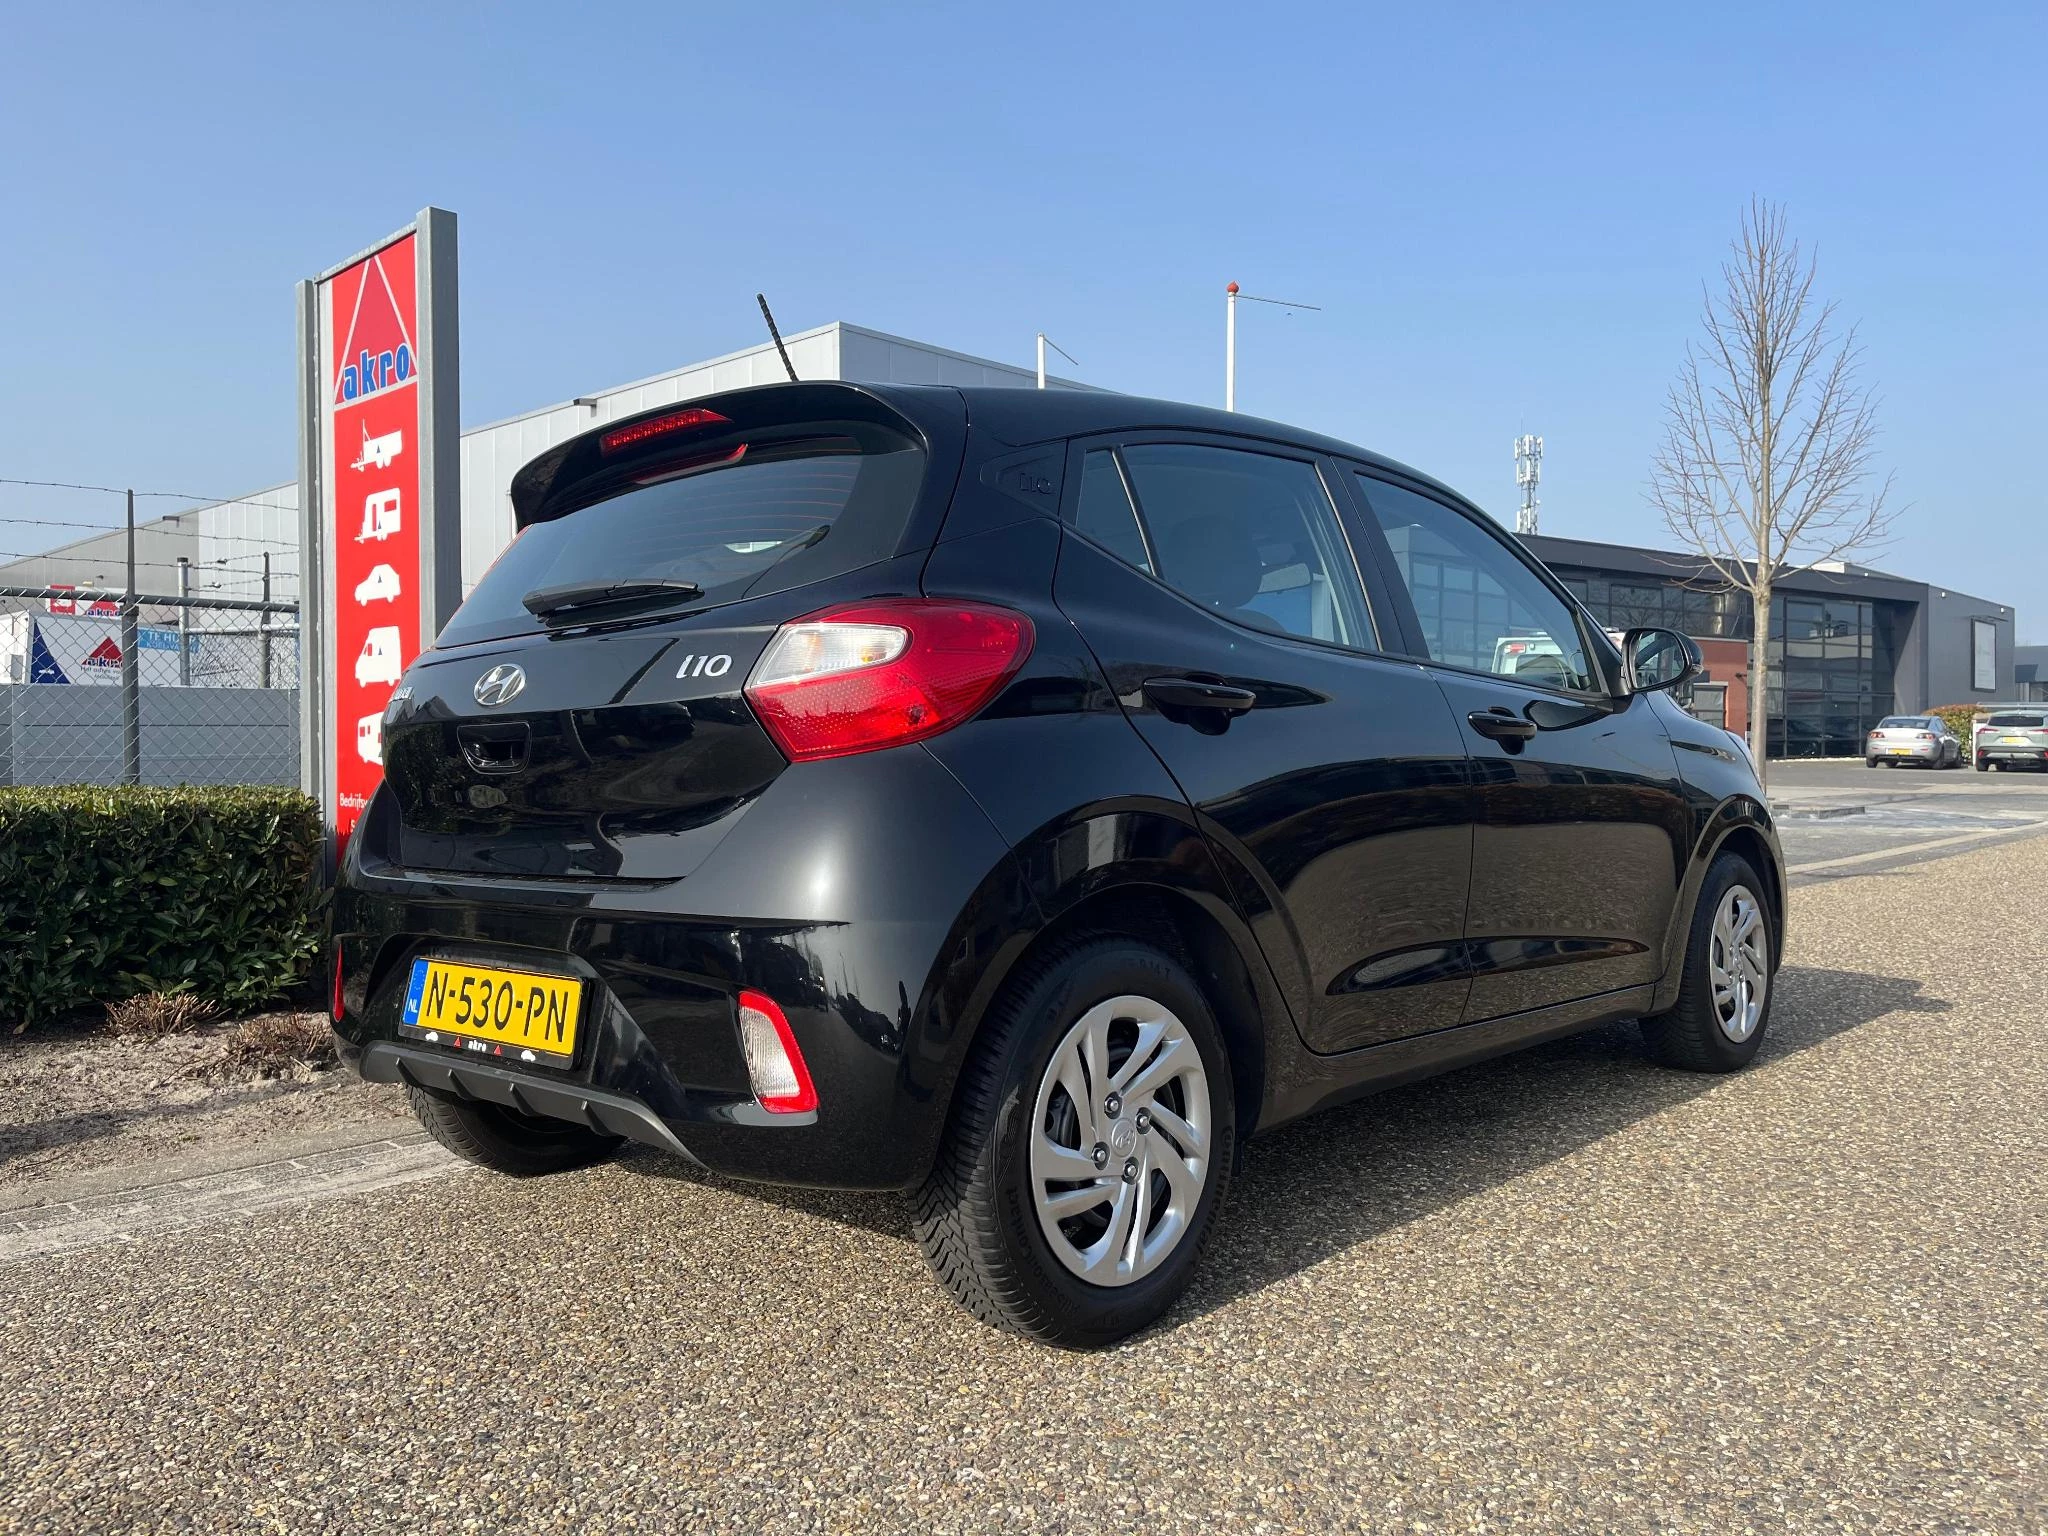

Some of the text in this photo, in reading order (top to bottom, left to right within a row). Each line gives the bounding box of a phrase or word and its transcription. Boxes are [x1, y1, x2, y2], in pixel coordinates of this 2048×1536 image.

[342, 343, 410, 401] akro
[88, 656, 123, 669] akr
[408, 999, 418, 1013] NL
[426, 970, 568, 1042] N-530-PN
[468, 1039, 487, 1052] akro
